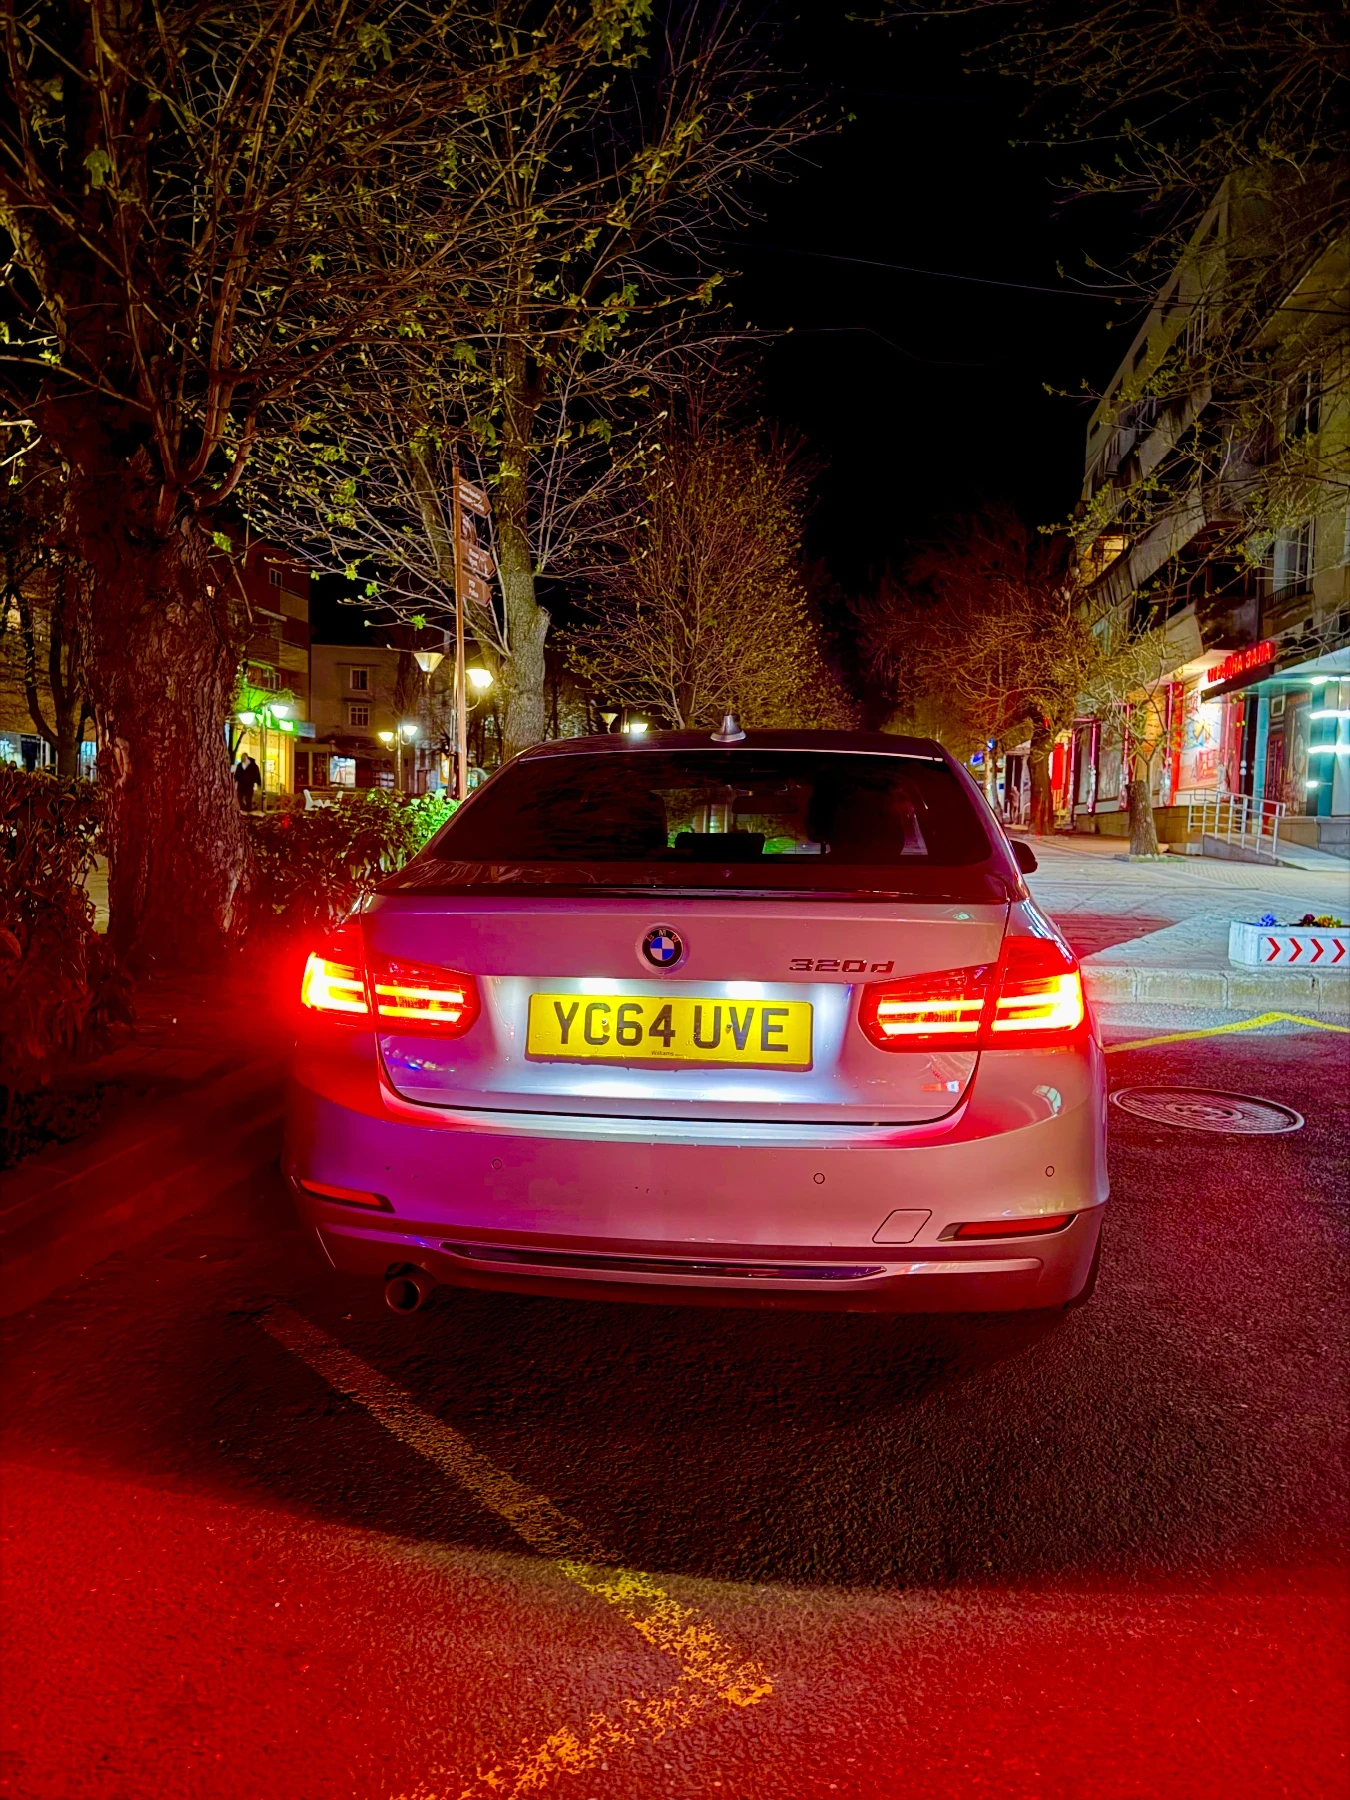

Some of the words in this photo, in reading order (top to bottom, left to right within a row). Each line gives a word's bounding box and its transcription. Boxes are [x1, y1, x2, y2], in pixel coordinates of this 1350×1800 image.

[1246, 641, 1272, 669] ЗАЛА
[645, 929, 679, 942] BMW
[789, 958, 895, 974] 320d
[553, 1001, 676, 1048] YC64
[693, 1004, 790, 1052] UVE
